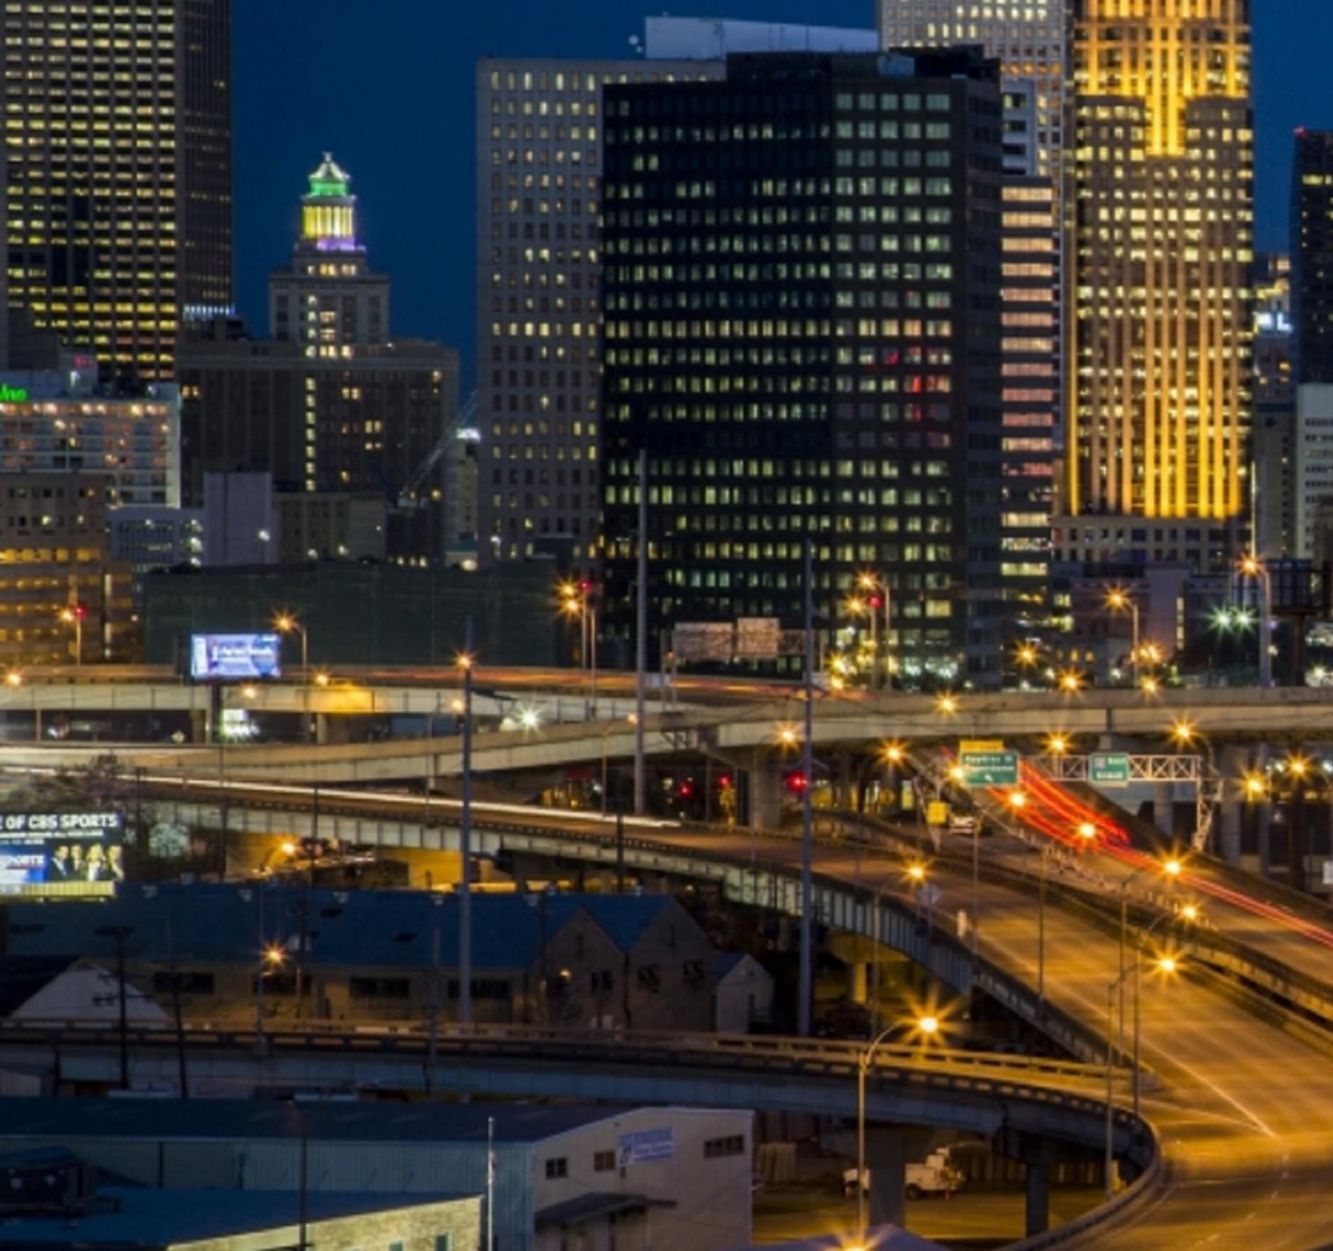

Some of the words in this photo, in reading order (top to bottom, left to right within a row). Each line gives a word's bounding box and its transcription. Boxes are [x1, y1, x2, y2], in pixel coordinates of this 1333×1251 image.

[6, 815, 25, 829] OF
[28, 815, 57, 829] CBS
[60, 814, 117, 829] SPORTS
